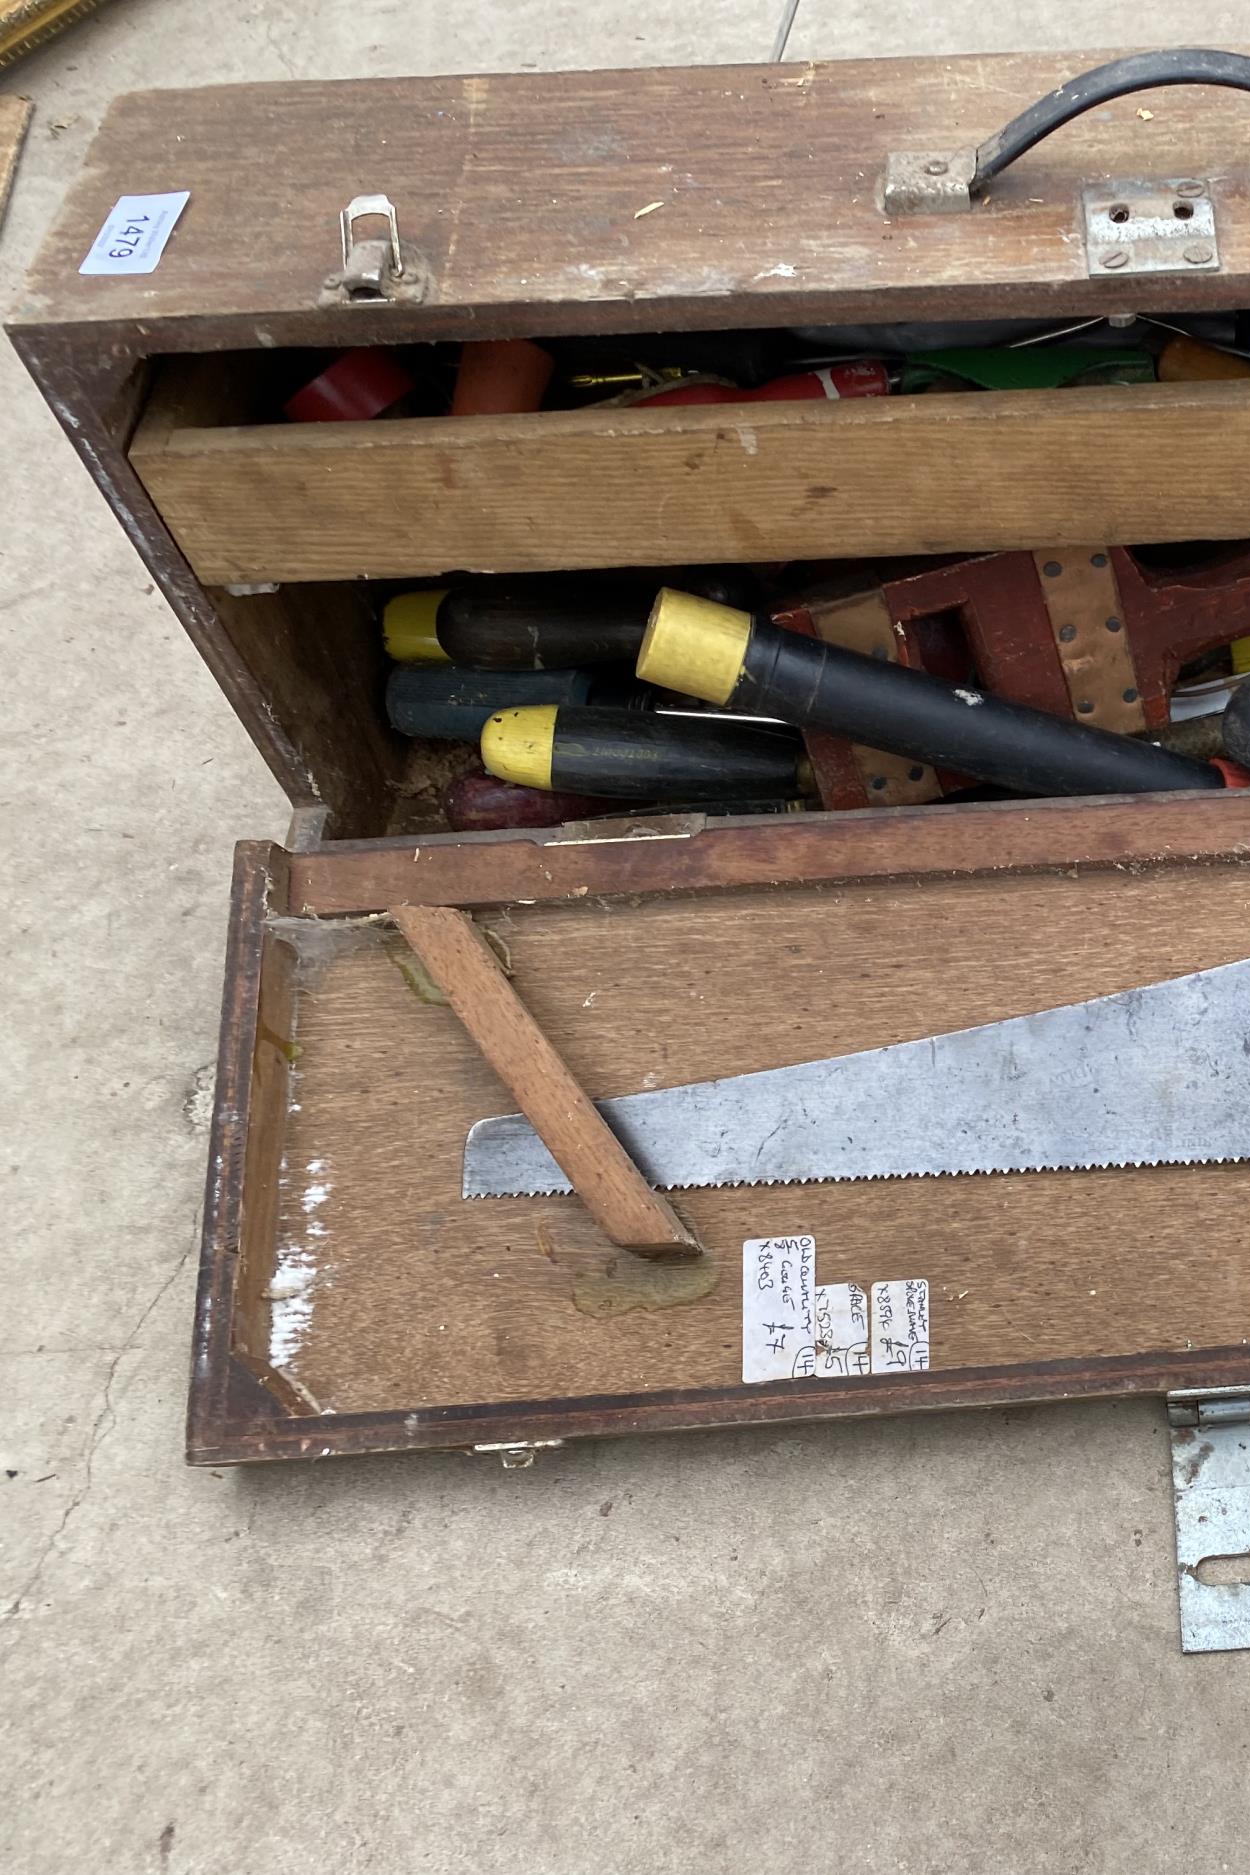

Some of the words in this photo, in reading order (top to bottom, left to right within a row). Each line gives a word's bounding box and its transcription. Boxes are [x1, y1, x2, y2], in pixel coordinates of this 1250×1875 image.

[109, 215, 150, 258] 1479
[800, 1237, 813, 1264] OLD
[762, 1321, 795, 1354] £7
[797, 1353, 814, 1375] 14
[852, 1351, 869, 1374] 14
[879, 1336, 910, 1368] £9
[914, 1350, 928, 1370] 14
